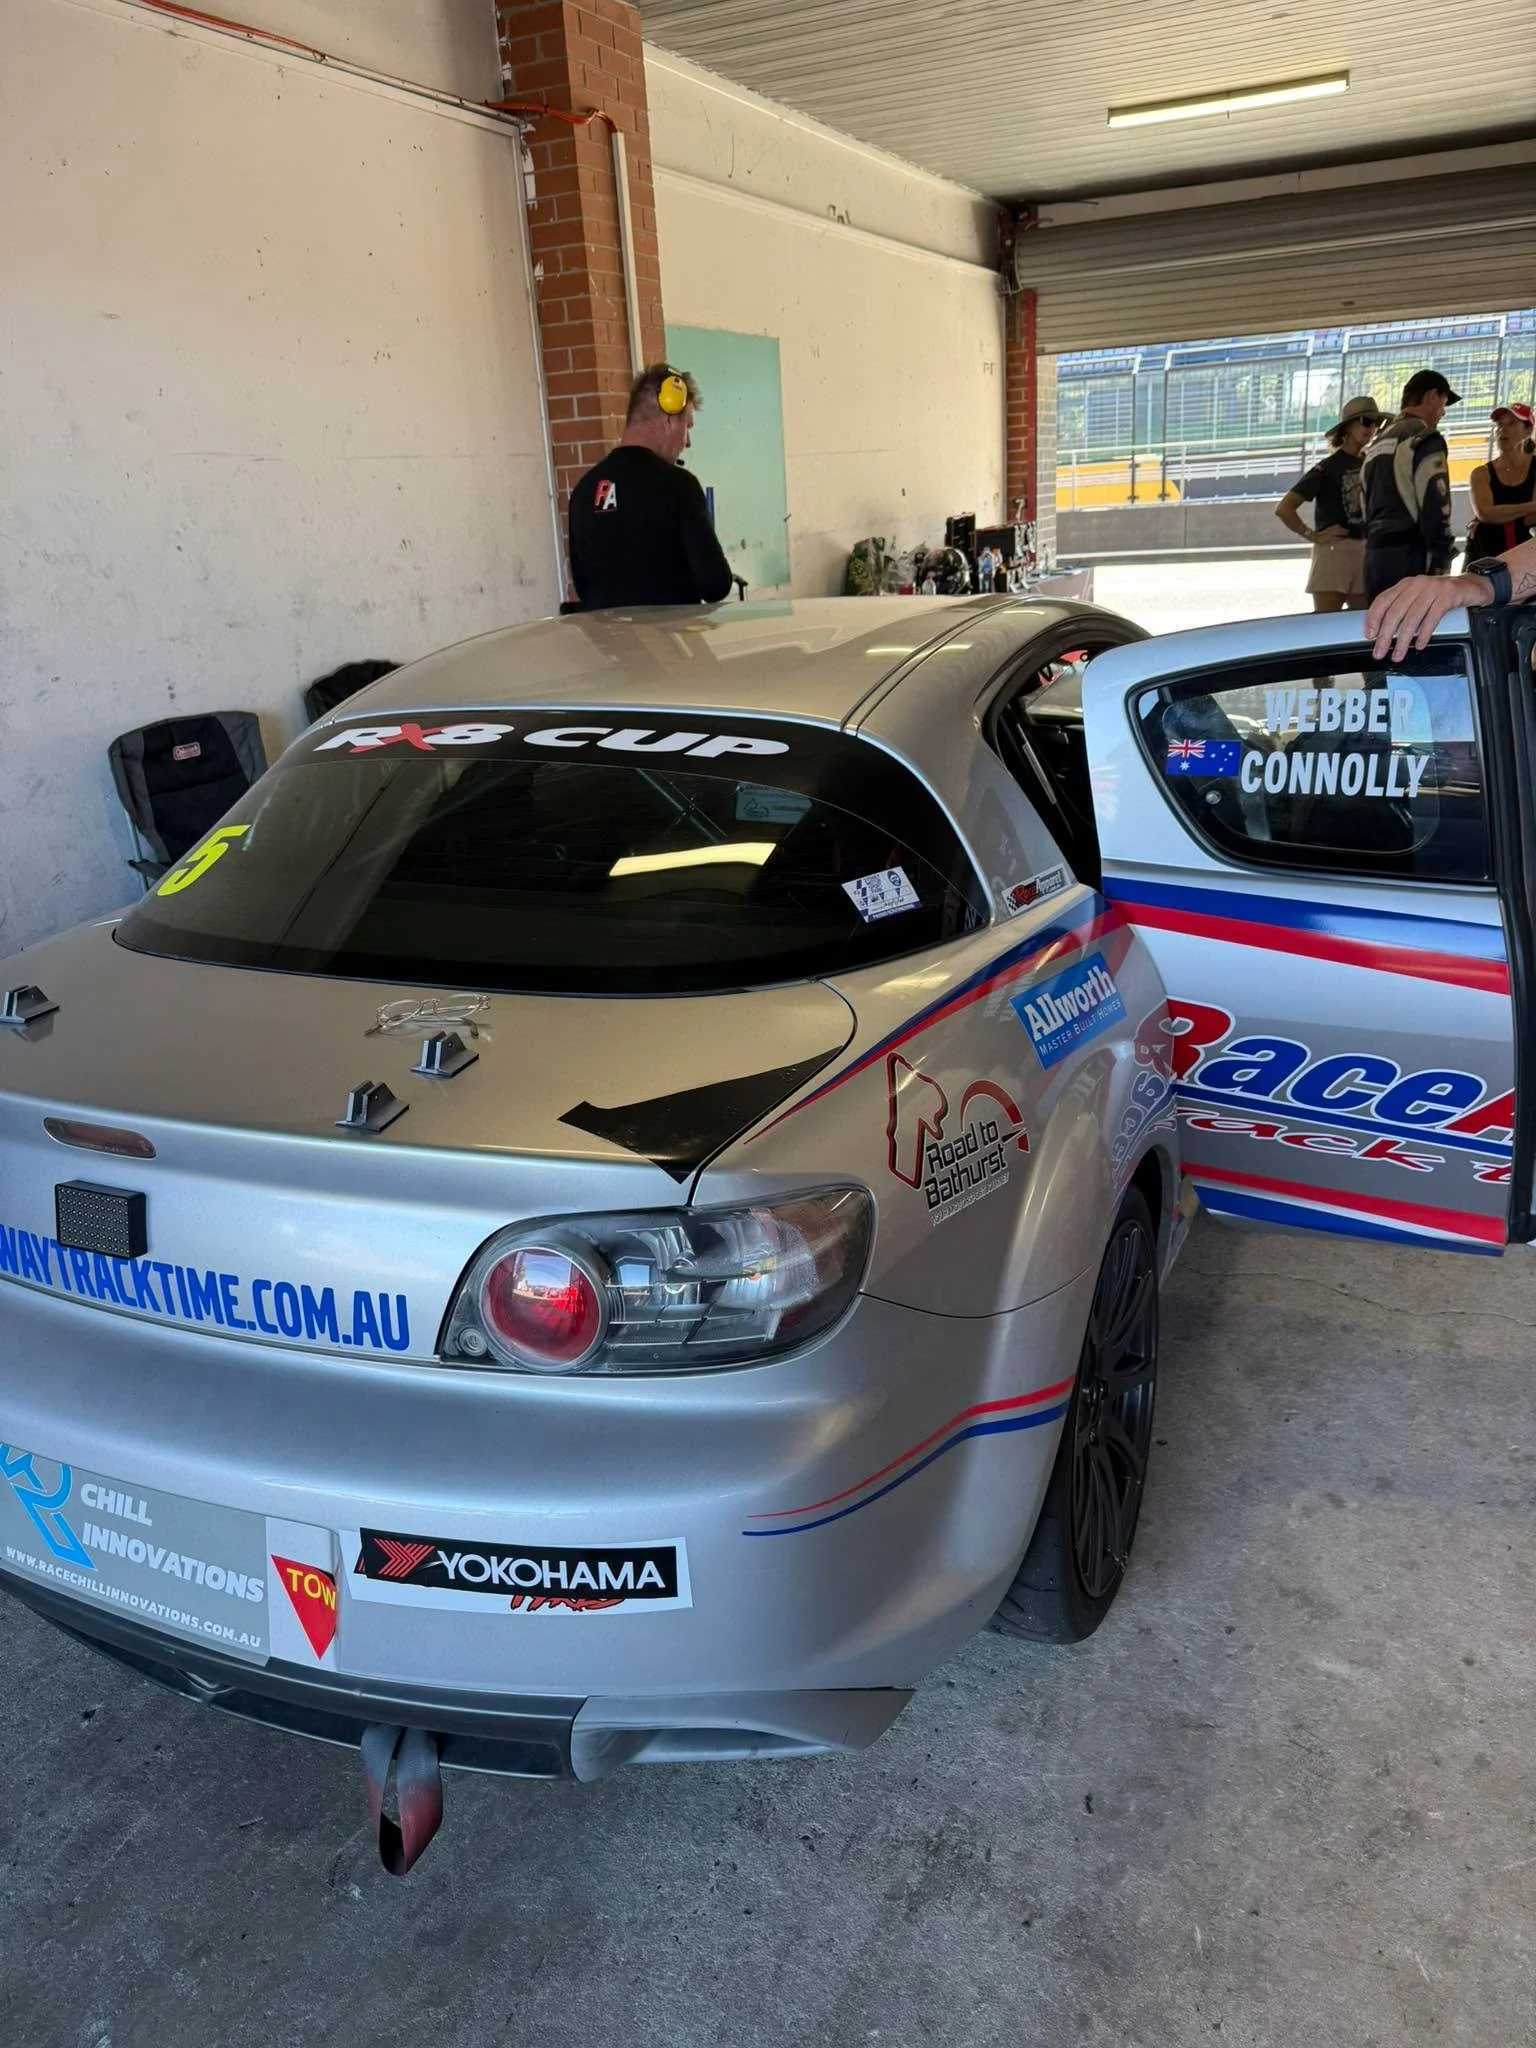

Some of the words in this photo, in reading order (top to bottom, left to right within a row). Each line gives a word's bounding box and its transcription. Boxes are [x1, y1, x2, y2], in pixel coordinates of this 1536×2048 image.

[1264, 687, 1415, 733] WEBBER
[312, 723, 515, 753] RX8
[523, 726, 790, 758] CUP
[1240, 750, 1430, 798] CONNOLLY
[156, 824, 251, 896] 5
[1023, 964, 1118, 1042] Allworth
[1039, 1031, 1073, 1057] MASTER
[1073, 1014, 1097, 1035] BUILT
[1099, 999, 1121, 1020] HOMES
[925, 1123, 977, 1174] Road
[980, 1120, 999, 1142] to
[924, 1146, 1007, 1210] Bathurst
[80, 1482, 152, 1526] CHILL
[82, 1522, 265, 1603] INNOVATIONS
[437, 1550, 666, 1590] YOKOHAMA
[286, 1567, 337, 1611] TOW
